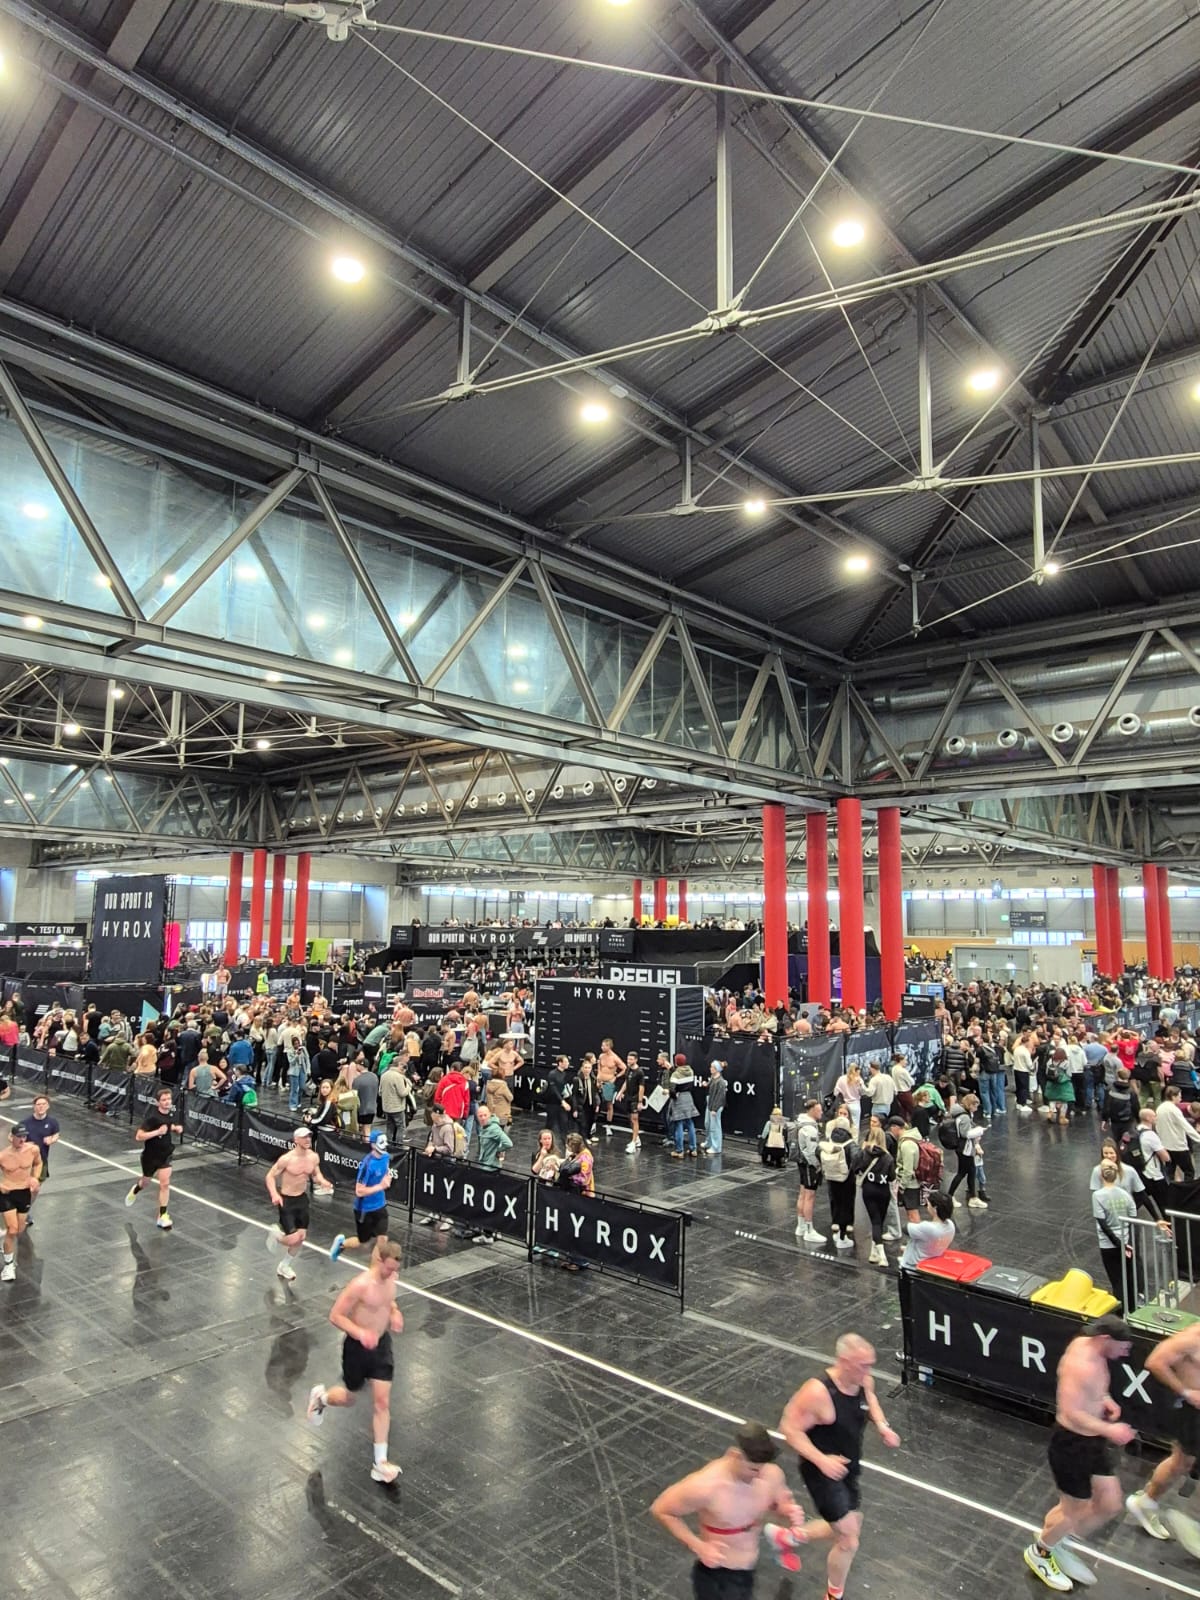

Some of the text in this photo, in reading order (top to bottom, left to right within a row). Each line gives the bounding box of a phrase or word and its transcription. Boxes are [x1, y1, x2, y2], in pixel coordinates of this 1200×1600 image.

[104, 891, 153, 910] OUR SPORT IS
[39, 926, 55, 934] TEST
[62, 926, 76, 934] TRY
[101, 920, 152, 939] HYROX
[469, 933, 516, 943] HYROX
[573, 986, 626, 1001] HYROX
[324, 1151, 340, 1165] BOSS
[423, 1172, 517, 1220] HYROX
[545, 1206, 666, 1263] HYROX
[928, 1310, 1153, 1405] HYRX
